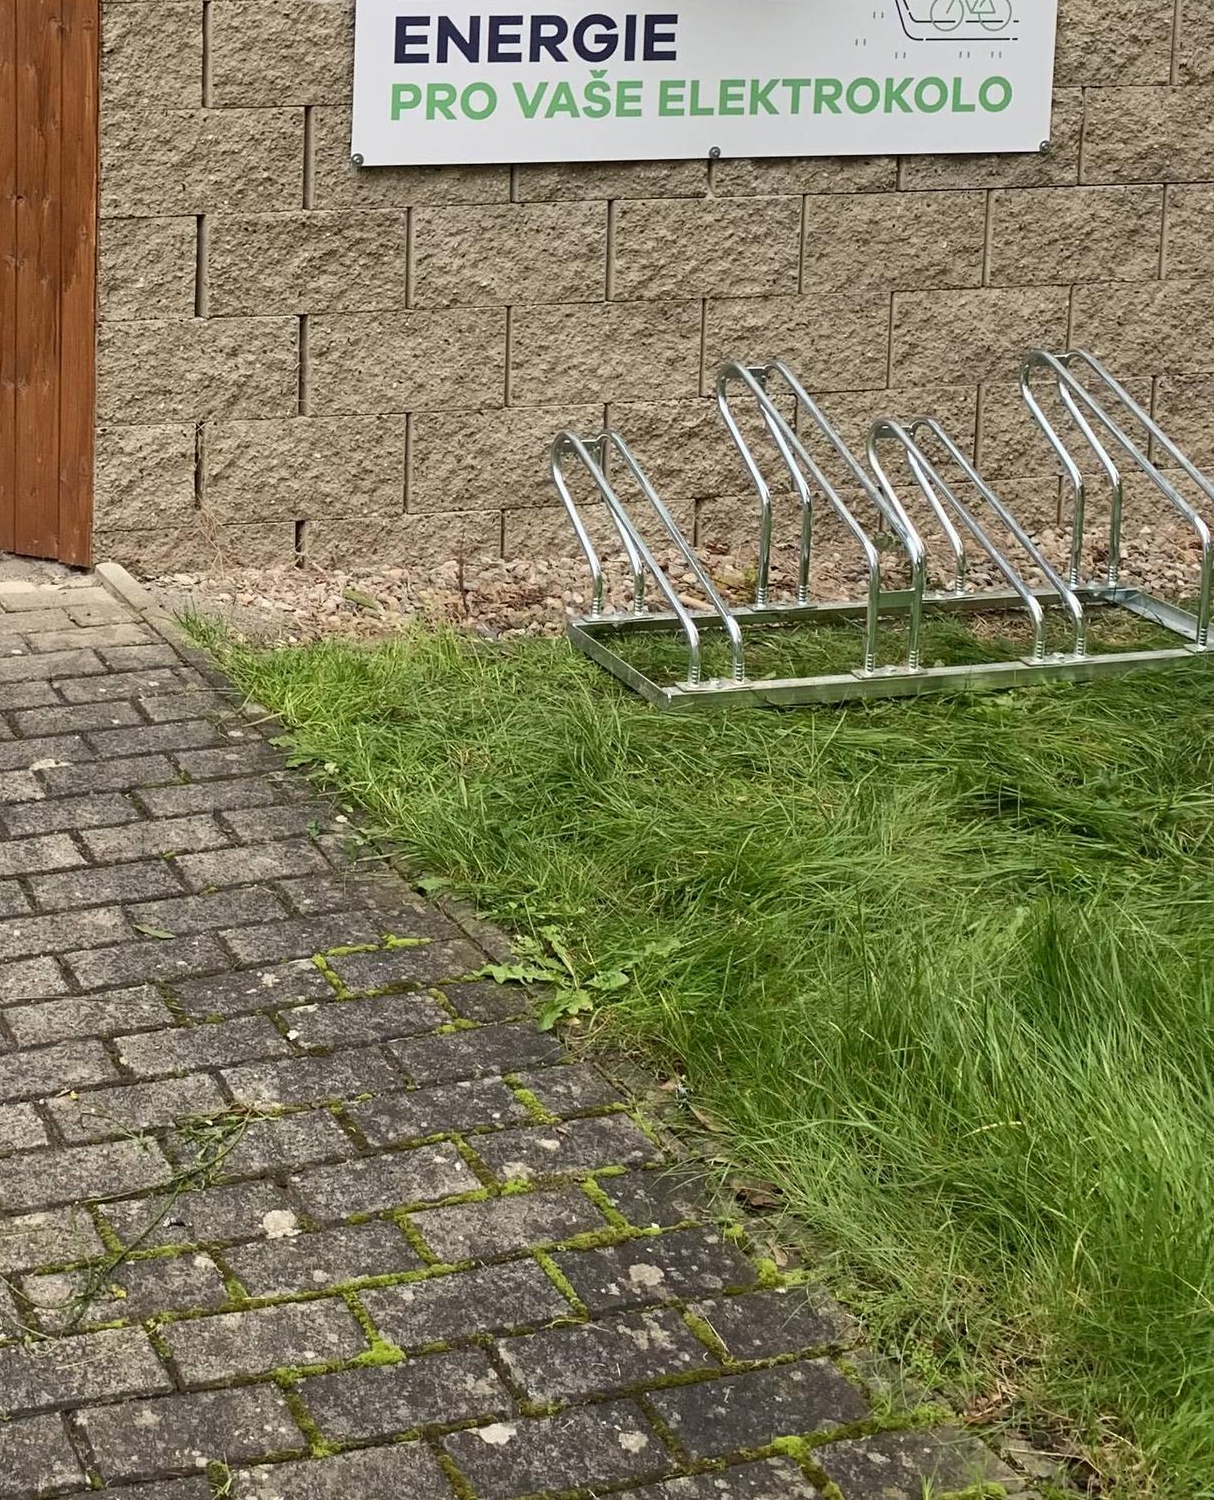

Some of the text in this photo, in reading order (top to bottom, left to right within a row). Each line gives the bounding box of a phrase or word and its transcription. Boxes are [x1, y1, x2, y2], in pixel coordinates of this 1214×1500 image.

[394, 13, 678, 63] ENERGIE
[391, 70, 1014, 120] PRO VAŠE ELEKTROKOLO
